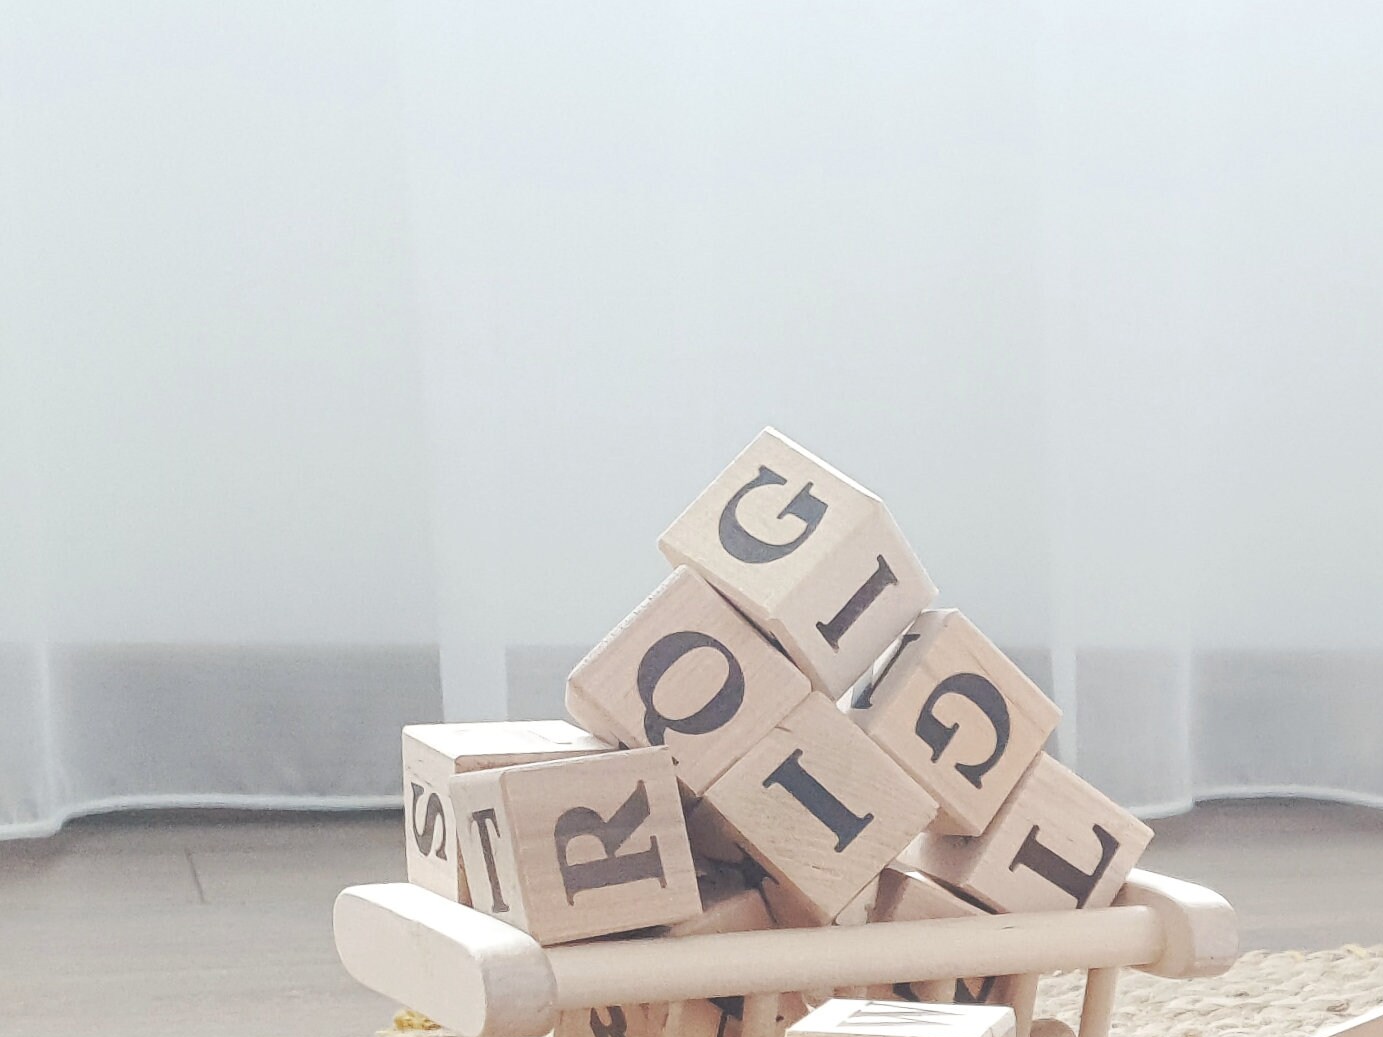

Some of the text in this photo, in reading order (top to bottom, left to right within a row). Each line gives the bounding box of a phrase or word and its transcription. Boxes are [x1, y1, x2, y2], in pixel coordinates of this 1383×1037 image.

[719, 465, 828, 563] G
[816, 554, 898, 652] I
[915, 673, 1011, 789] G
[410, 782, 447, 861] S
[554, 779, 666, 906] R
[762, 748, 874, 853] I
[472, 808, 509, 912] T
